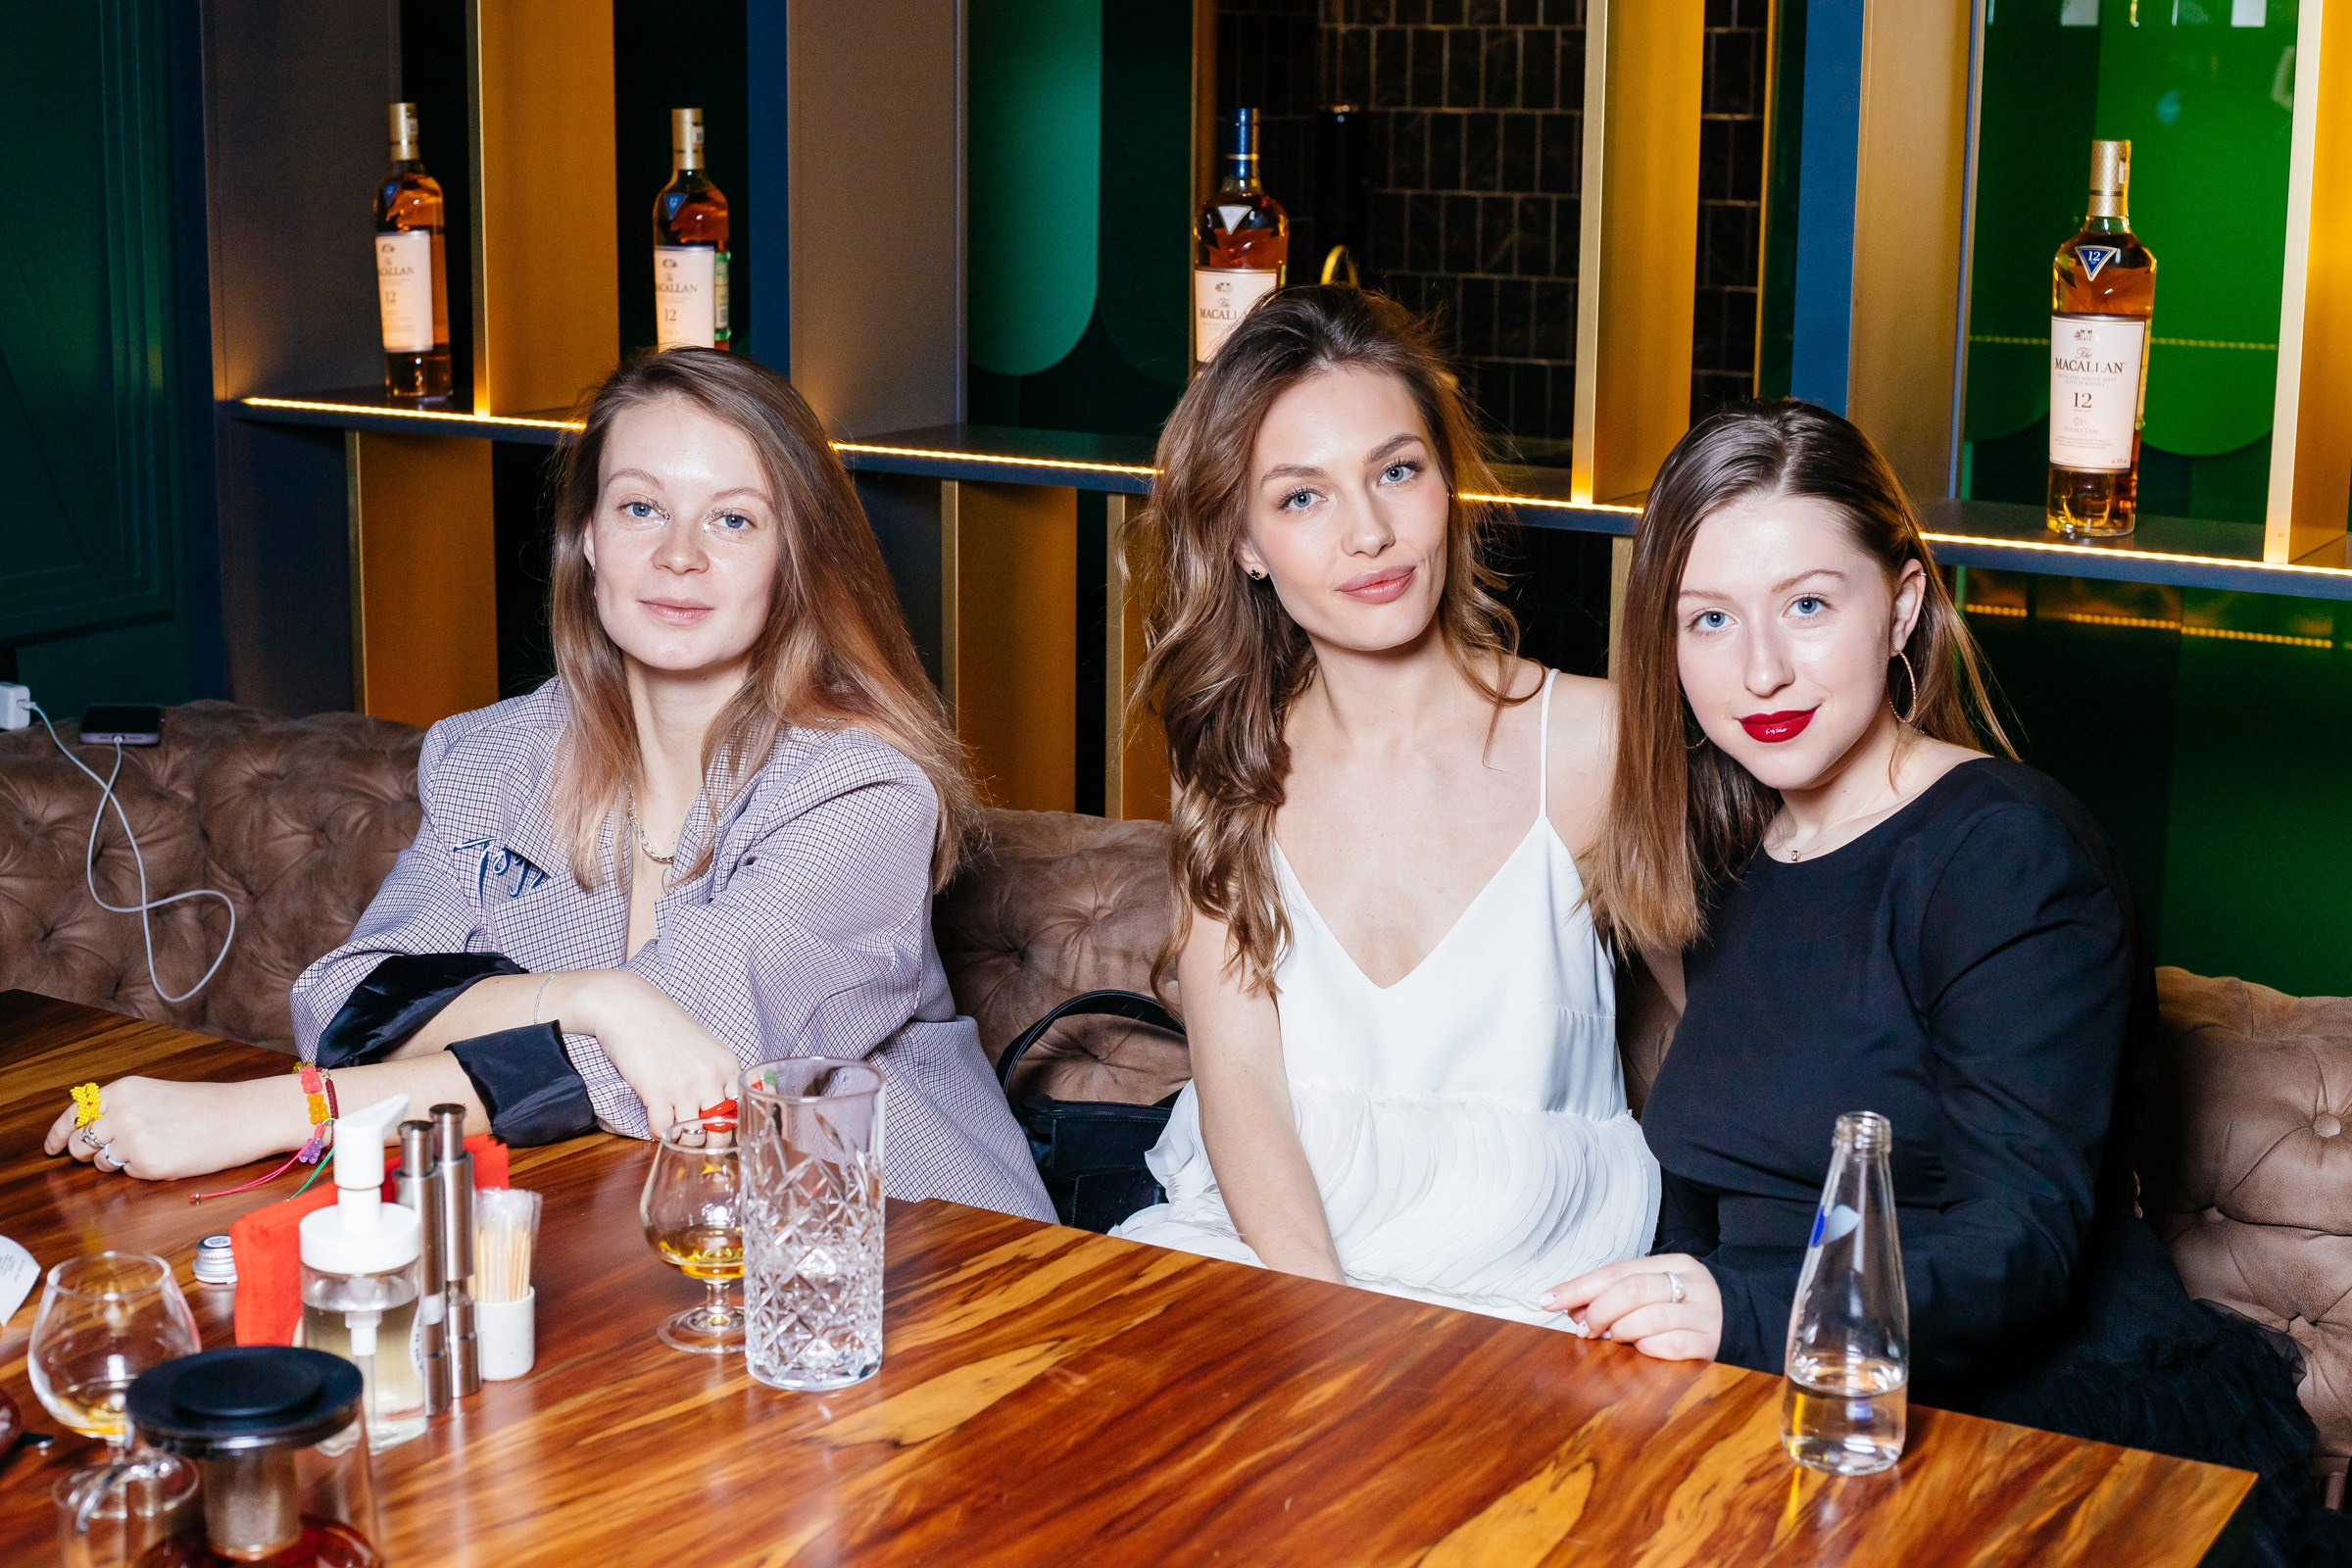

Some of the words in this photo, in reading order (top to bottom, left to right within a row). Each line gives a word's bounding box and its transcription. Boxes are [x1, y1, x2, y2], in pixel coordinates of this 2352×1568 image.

[2088, 251, 2101, 262] 12
[663, 308, 678, 321] 12
[2055, 357, 2125, 373] MACALLAN
[2073, 392, 2092, 409] 12
